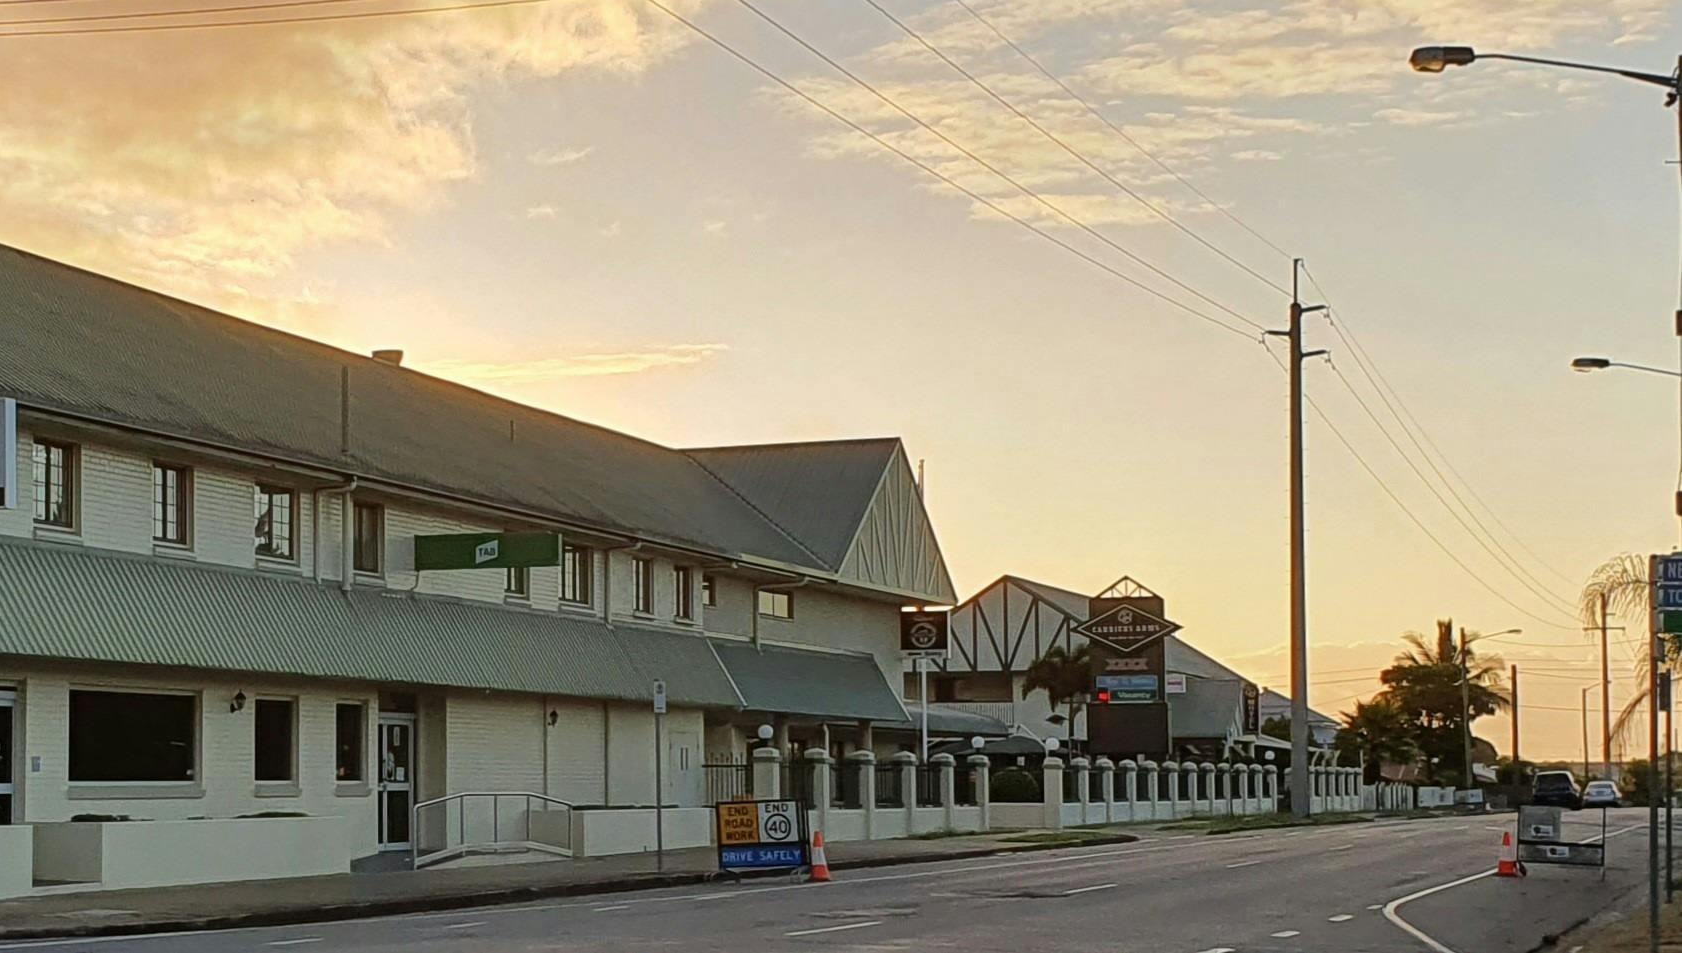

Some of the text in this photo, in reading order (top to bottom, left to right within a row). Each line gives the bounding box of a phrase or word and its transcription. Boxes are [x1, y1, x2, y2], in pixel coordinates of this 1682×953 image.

[478, 547, 496, 558] TAB
[1135, 624, 1160, 632] ARMS
[727, 806, 749, 817] END
[765, 803, 789, 813] END
[724, 818, 754, 829] ROAD
[768, 820, 788, 835] 40
[726, 831, 756, 841] WORK
[722, 850, 801, 862] DRIVE SAFELY
